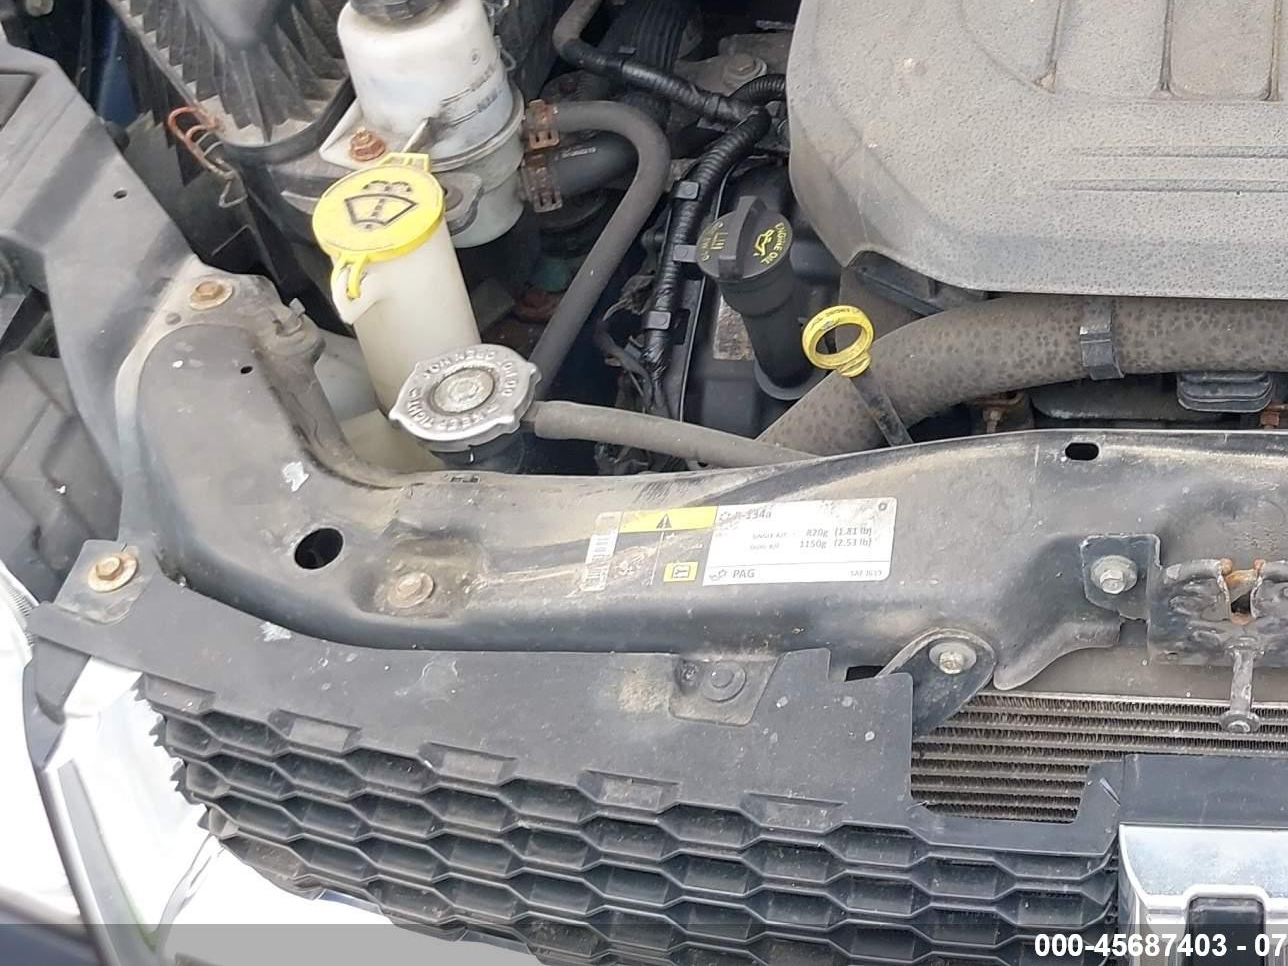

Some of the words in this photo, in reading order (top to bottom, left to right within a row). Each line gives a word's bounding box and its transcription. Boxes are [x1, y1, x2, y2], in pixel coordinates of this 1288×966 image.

[774, 222, 787, 251] ENGINE
[760, 251, 779, 265] OIL
[800, 539, 827, 550] 1150g
[860, 537, 872, 548] lb)
[732, 569, 755, 579] PAG
